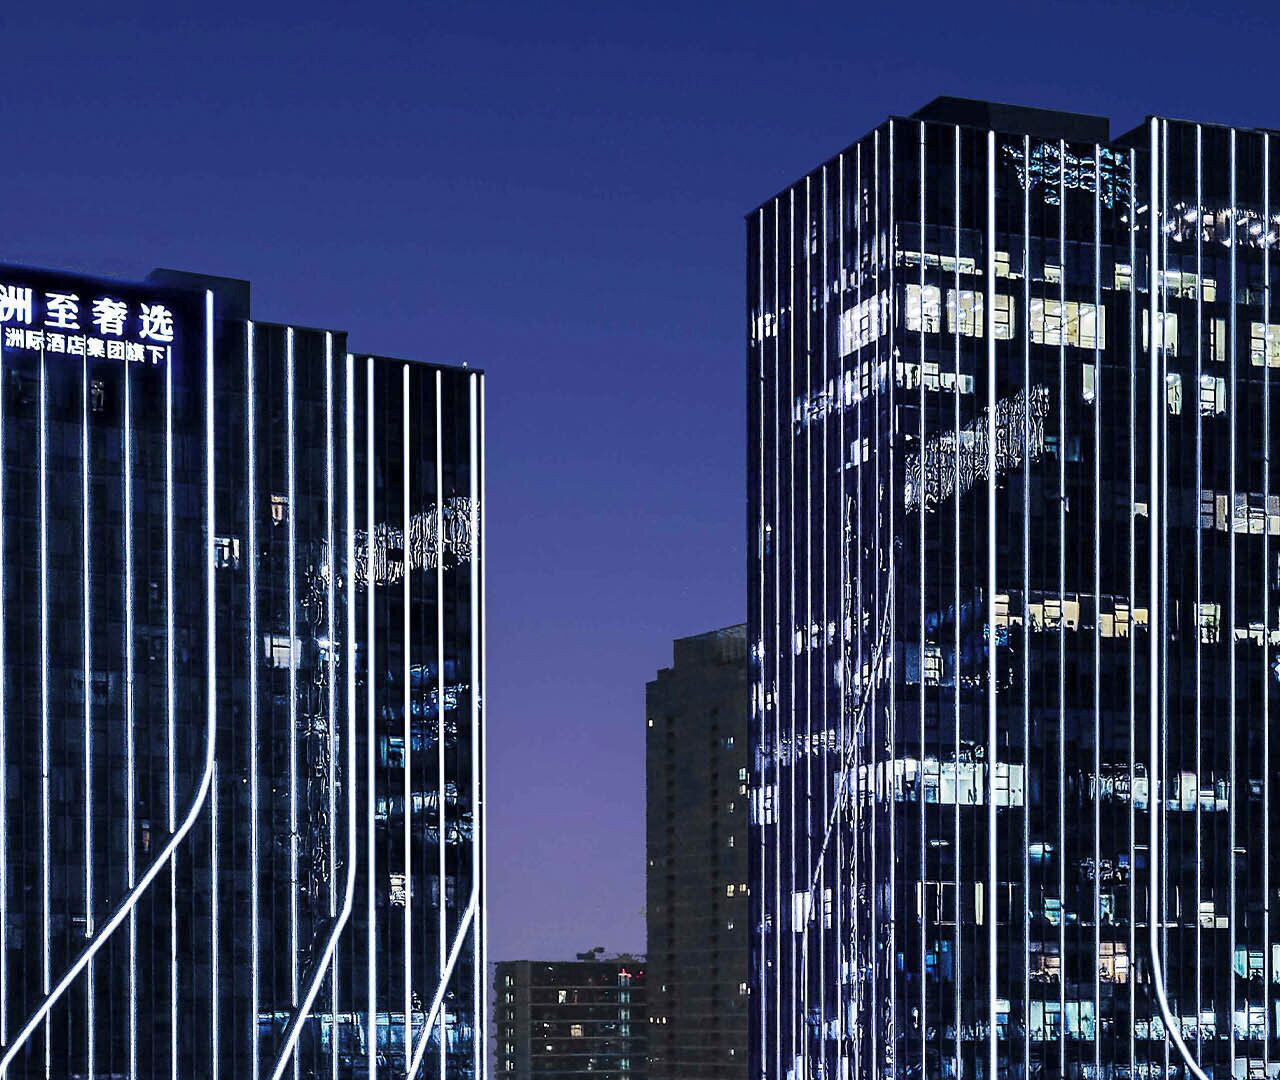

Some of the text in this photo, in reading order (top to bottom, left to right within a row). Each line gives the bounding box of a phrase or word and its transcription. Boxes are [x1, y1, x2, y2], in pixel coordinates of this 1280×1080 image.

[6, 327, 165, 364] 洲际酒店集团旗下
